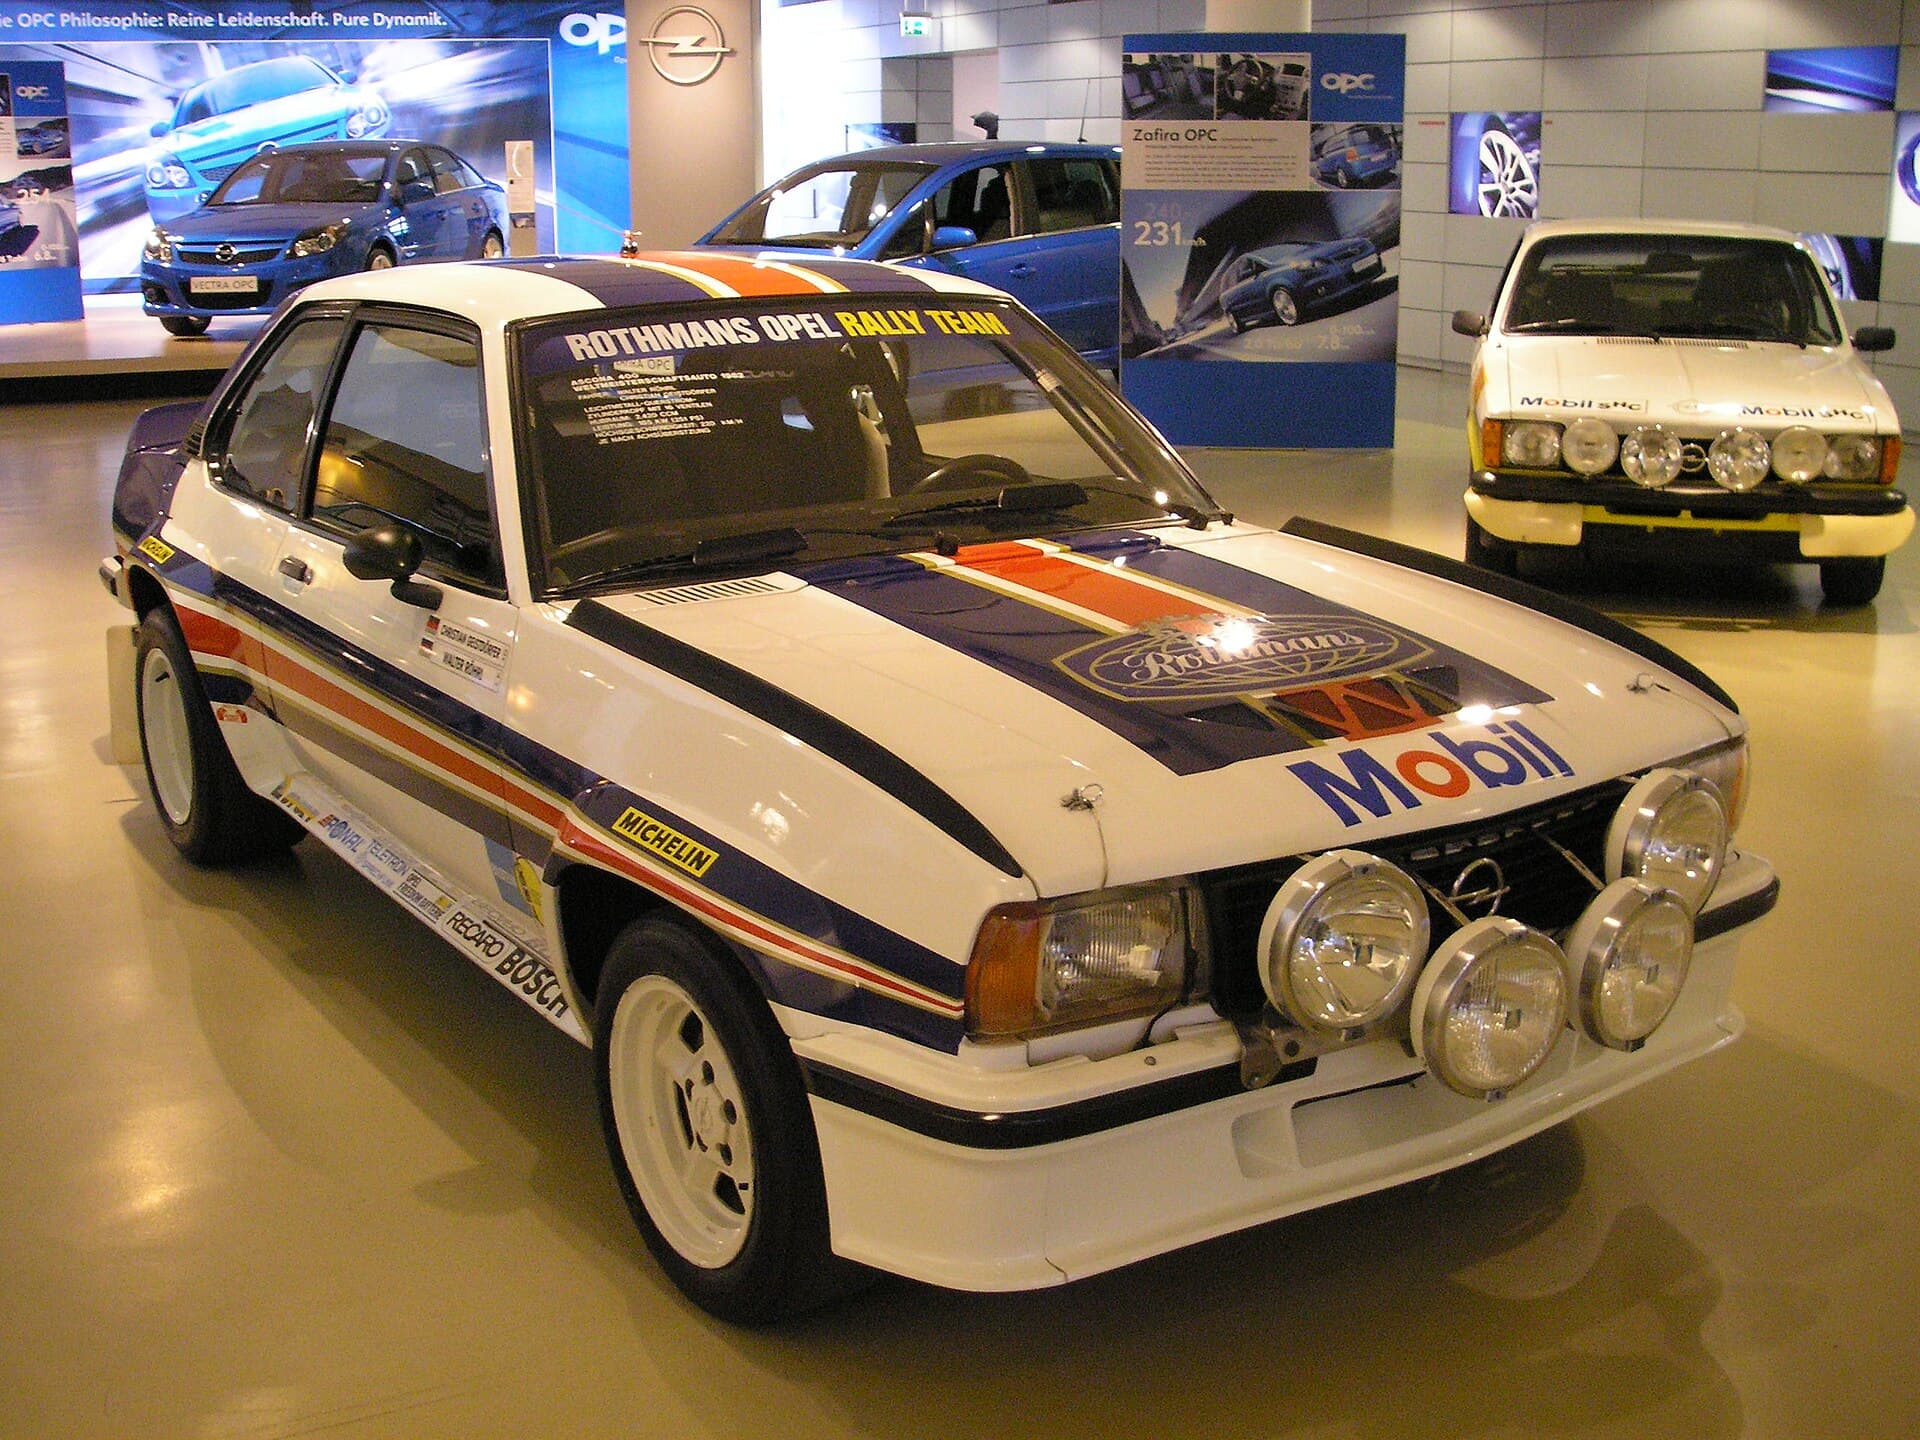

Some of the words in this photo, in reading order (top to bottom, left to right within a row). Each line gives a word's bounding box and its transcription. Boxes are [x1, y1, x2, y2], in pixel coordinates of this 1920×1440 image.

[17, 13, 56, 27] OPC
[60, 12, 163, 30] Philosophie:
[167, 13, 214, 27] Reine
[218, 12, 329, 26] Leidenschaft.
[333, 12, 369, 26] Pure
[373, 12, 447, 29] Dynamik.
[16, 86, 49, 99] opc
[1320, 73, 1375, 94] opc
[1132, 128, 1180, 142] Zafira
[1184, 128, 1218, 142] OPC
[1134, 221, 1182, 246] 231
[192, 280, 229, 290] VECTRA
[232, 280, 254, 289] OPC
[564, 317, 760, 361] ROTHMANS
[758, 312, 842, 342] OPEL
[833, 310, 926, 337] RALLY
[924, 310, 1011, 335] TEAM
[647, 359, 671, 371] OPC
[571, 375, 615, 386] ASCONA
[618, 372, 640, 380] 400
[572, 373, 718, 392] WELTMEISTERSCHAFTSAUTO
[1520, 397, 1592, 409] Mobil
[1742, 406, 1814, 418] Mobil
[1285, 720, 1576, 827] Mobil
[323, 816, 364, 853] RONAL
[618, 811, 712, 871] MICHELIN
[367, 838, 410, 877] TELETRON
[446, 911, 505, 957] RECARO
